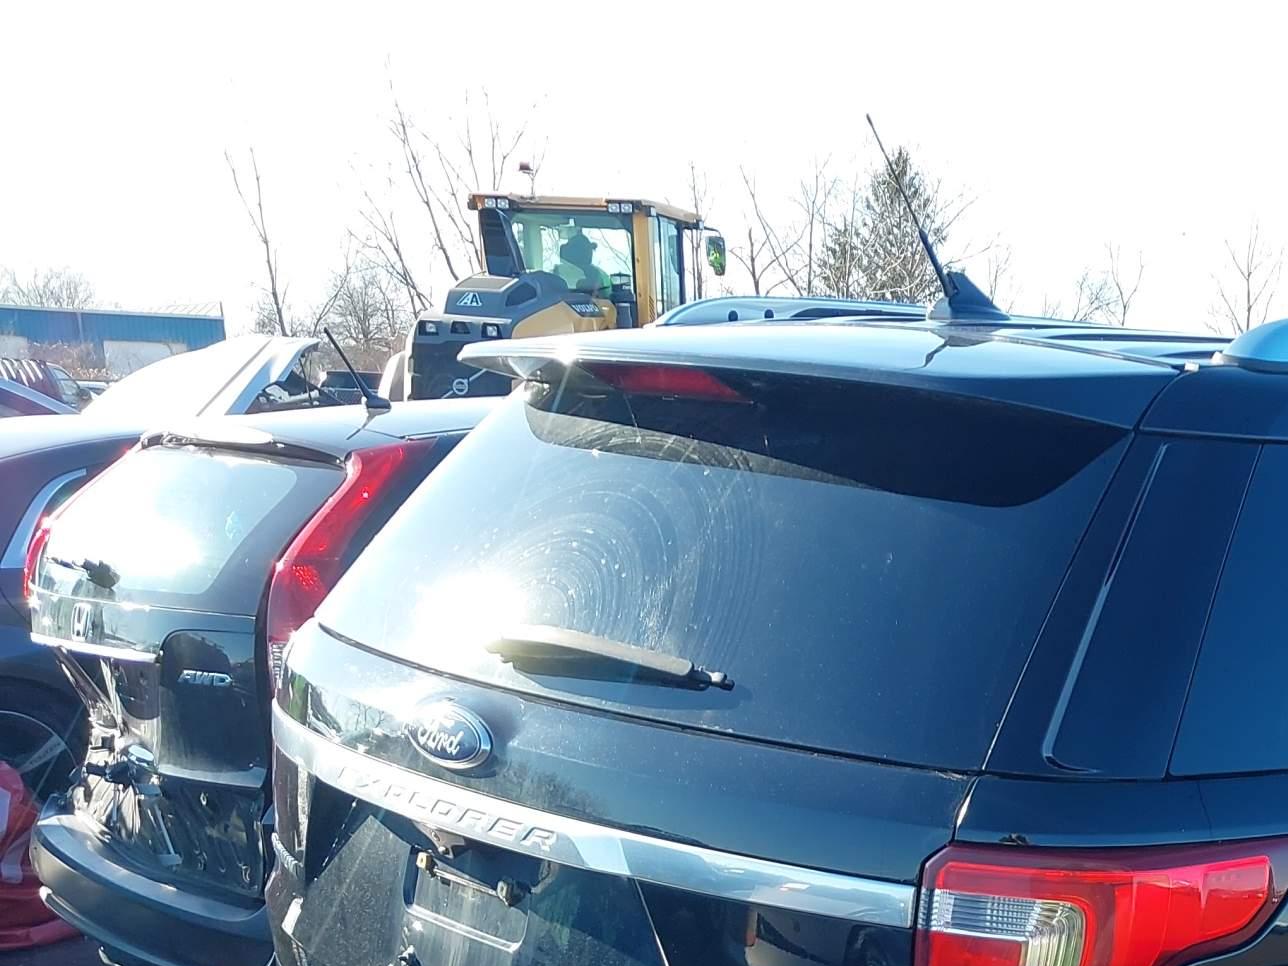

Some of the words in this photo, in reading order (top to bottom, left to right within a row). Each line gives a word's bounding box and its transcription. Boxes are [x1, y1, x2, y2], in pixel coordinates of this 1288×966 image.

[571, 303, 600, 313] VOLVO
[177, 669, 233, 687] AWD
[416, 719, 465, 756] Ford
